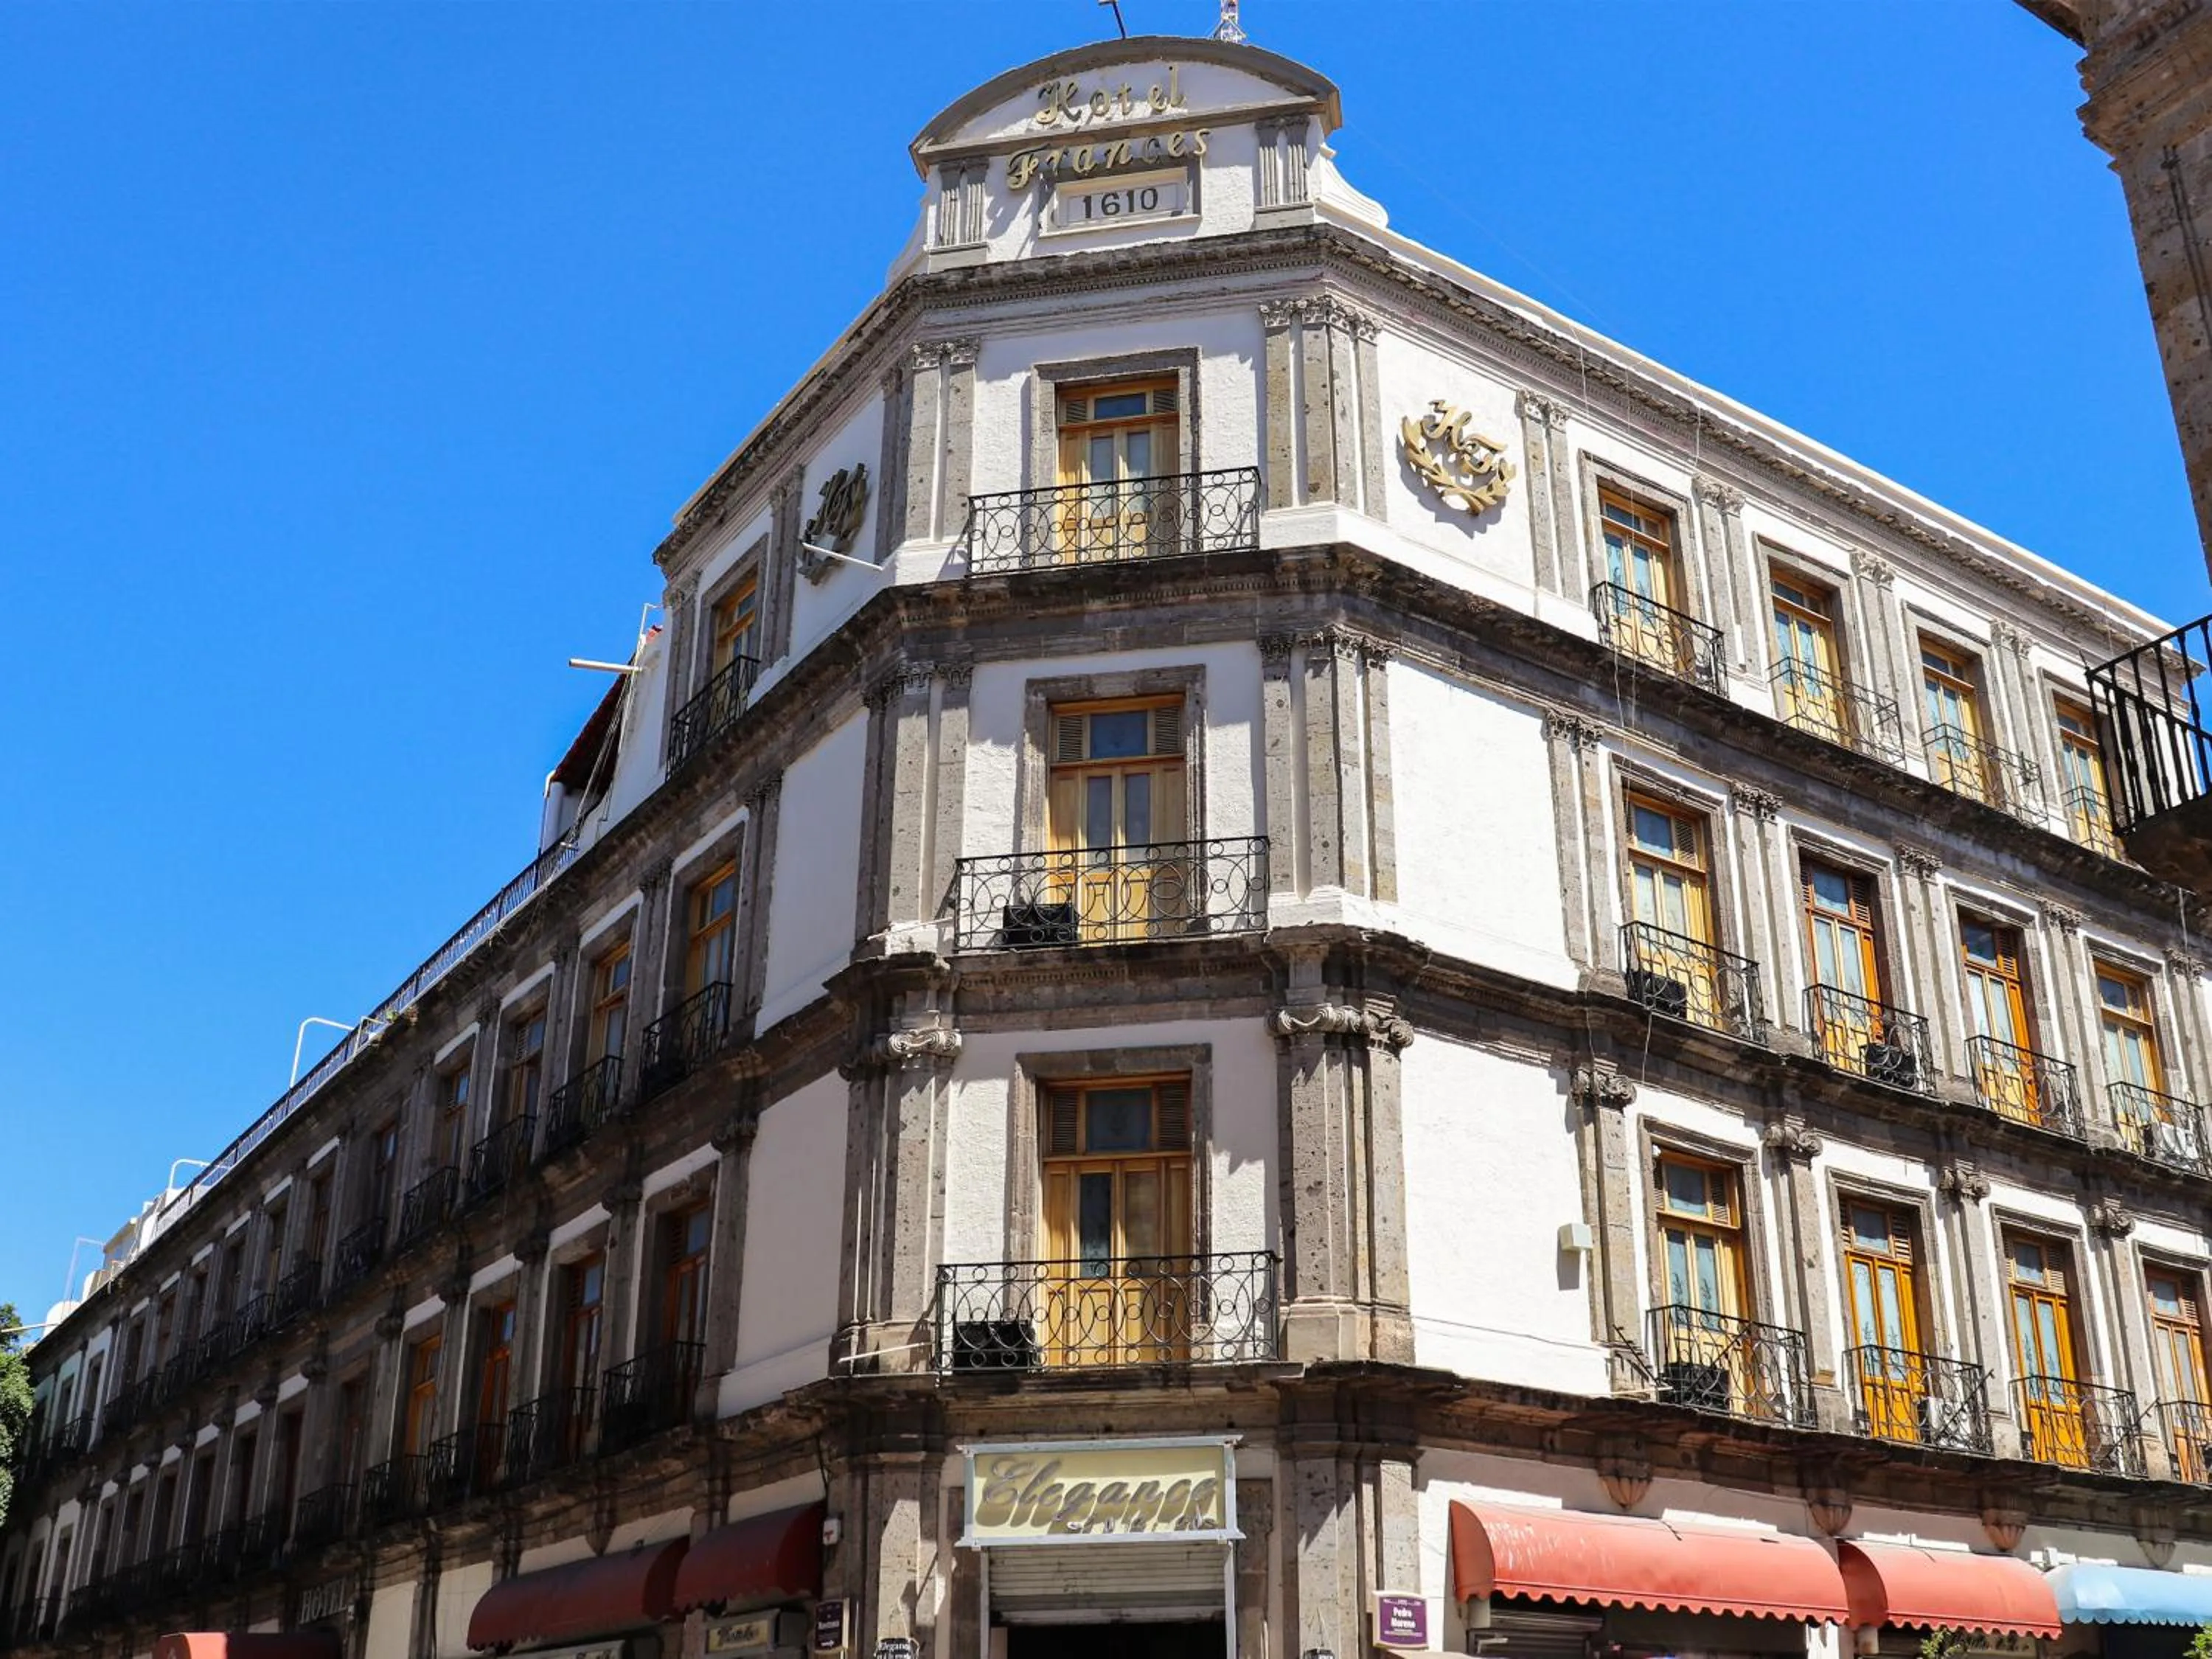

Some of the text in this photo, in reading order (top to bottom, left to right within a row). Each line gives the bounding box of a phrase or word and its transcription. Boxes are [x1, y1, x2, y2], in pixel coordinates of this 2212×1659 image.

[1036, 63, 1186, 124] Hotel
[1006, 128, 1211, 190] Frances
[1082, 187, 1158, 219] 1610
[982, 1456, 1218, 1522] Elegance
[299, 1577, 347, 1624] HOTEL
